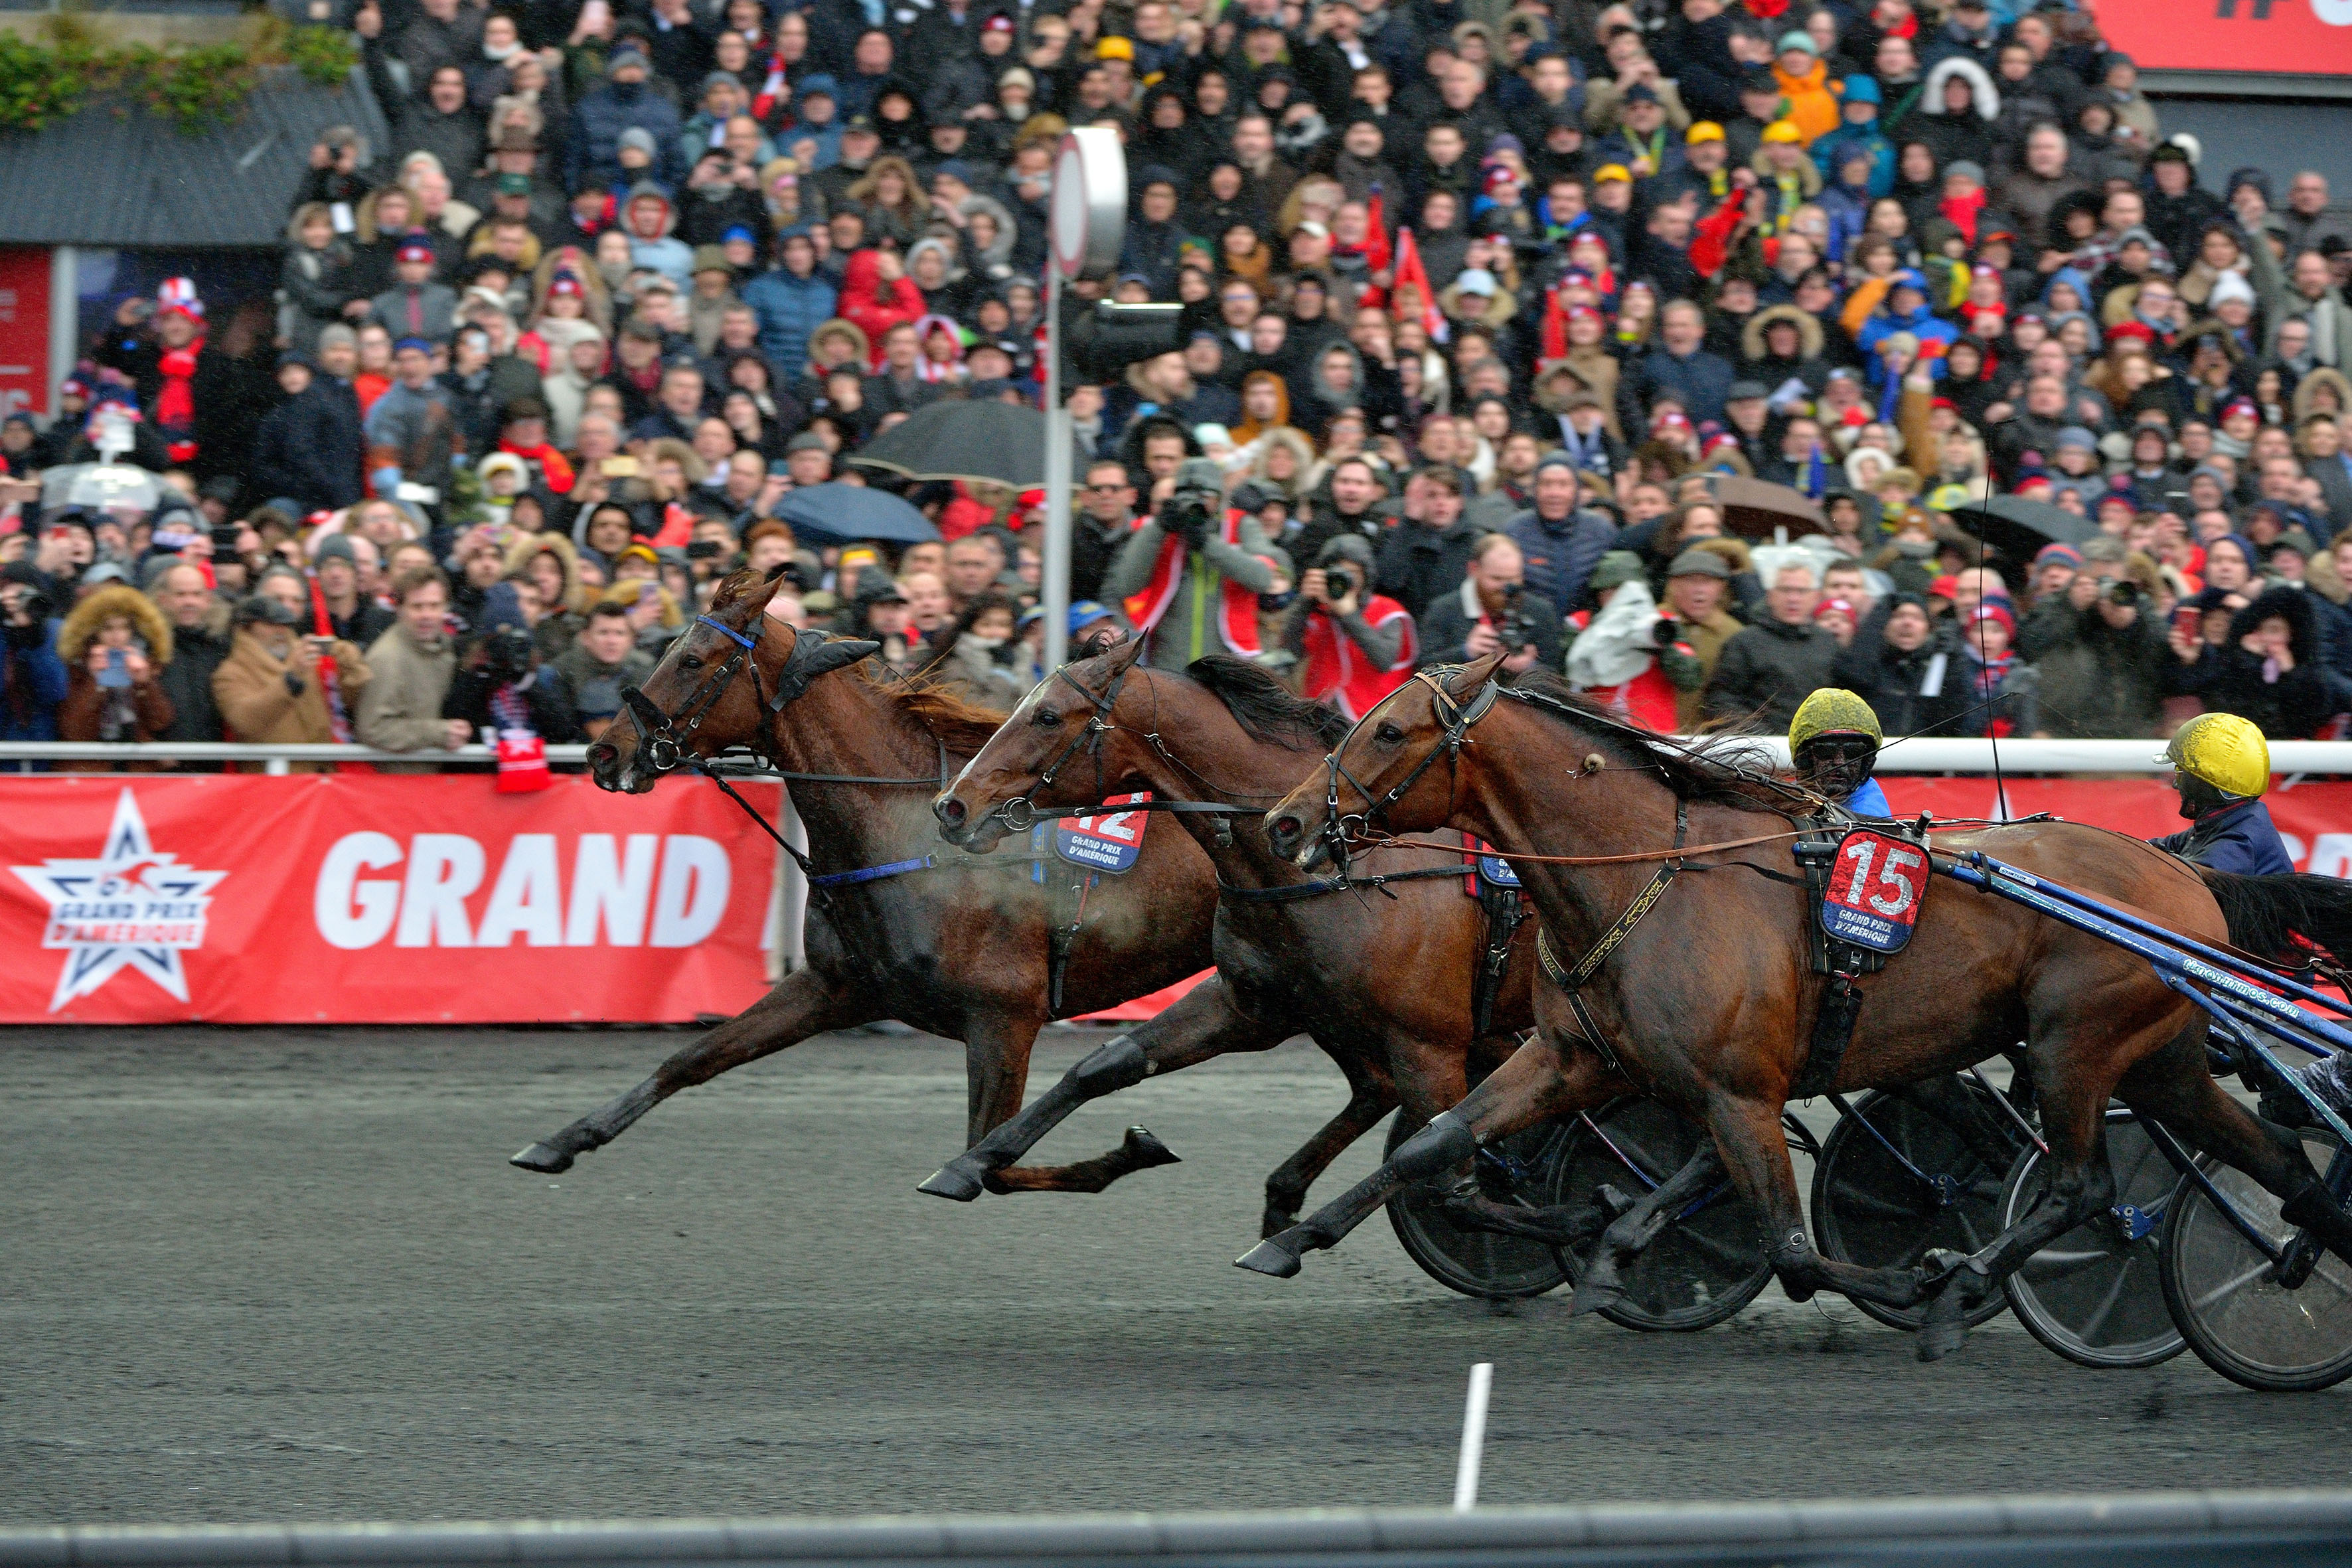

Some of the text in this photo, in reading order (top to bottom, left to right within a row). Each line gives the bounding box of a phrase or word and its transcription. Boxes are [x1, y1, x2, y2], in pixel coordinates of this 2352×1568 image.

[1069, 846, 1120, 866] D'AMÉRIQUE
[1071, 835, 1123, 856] GRAND PRIX
[313, 830, 730, 949] GRAND
[1847, 840, 1922, 915] 15
[1578, 879, 1662, 976] READLY EXPRESS
[1838, 909, 1893, 933] GRAND PRIX
